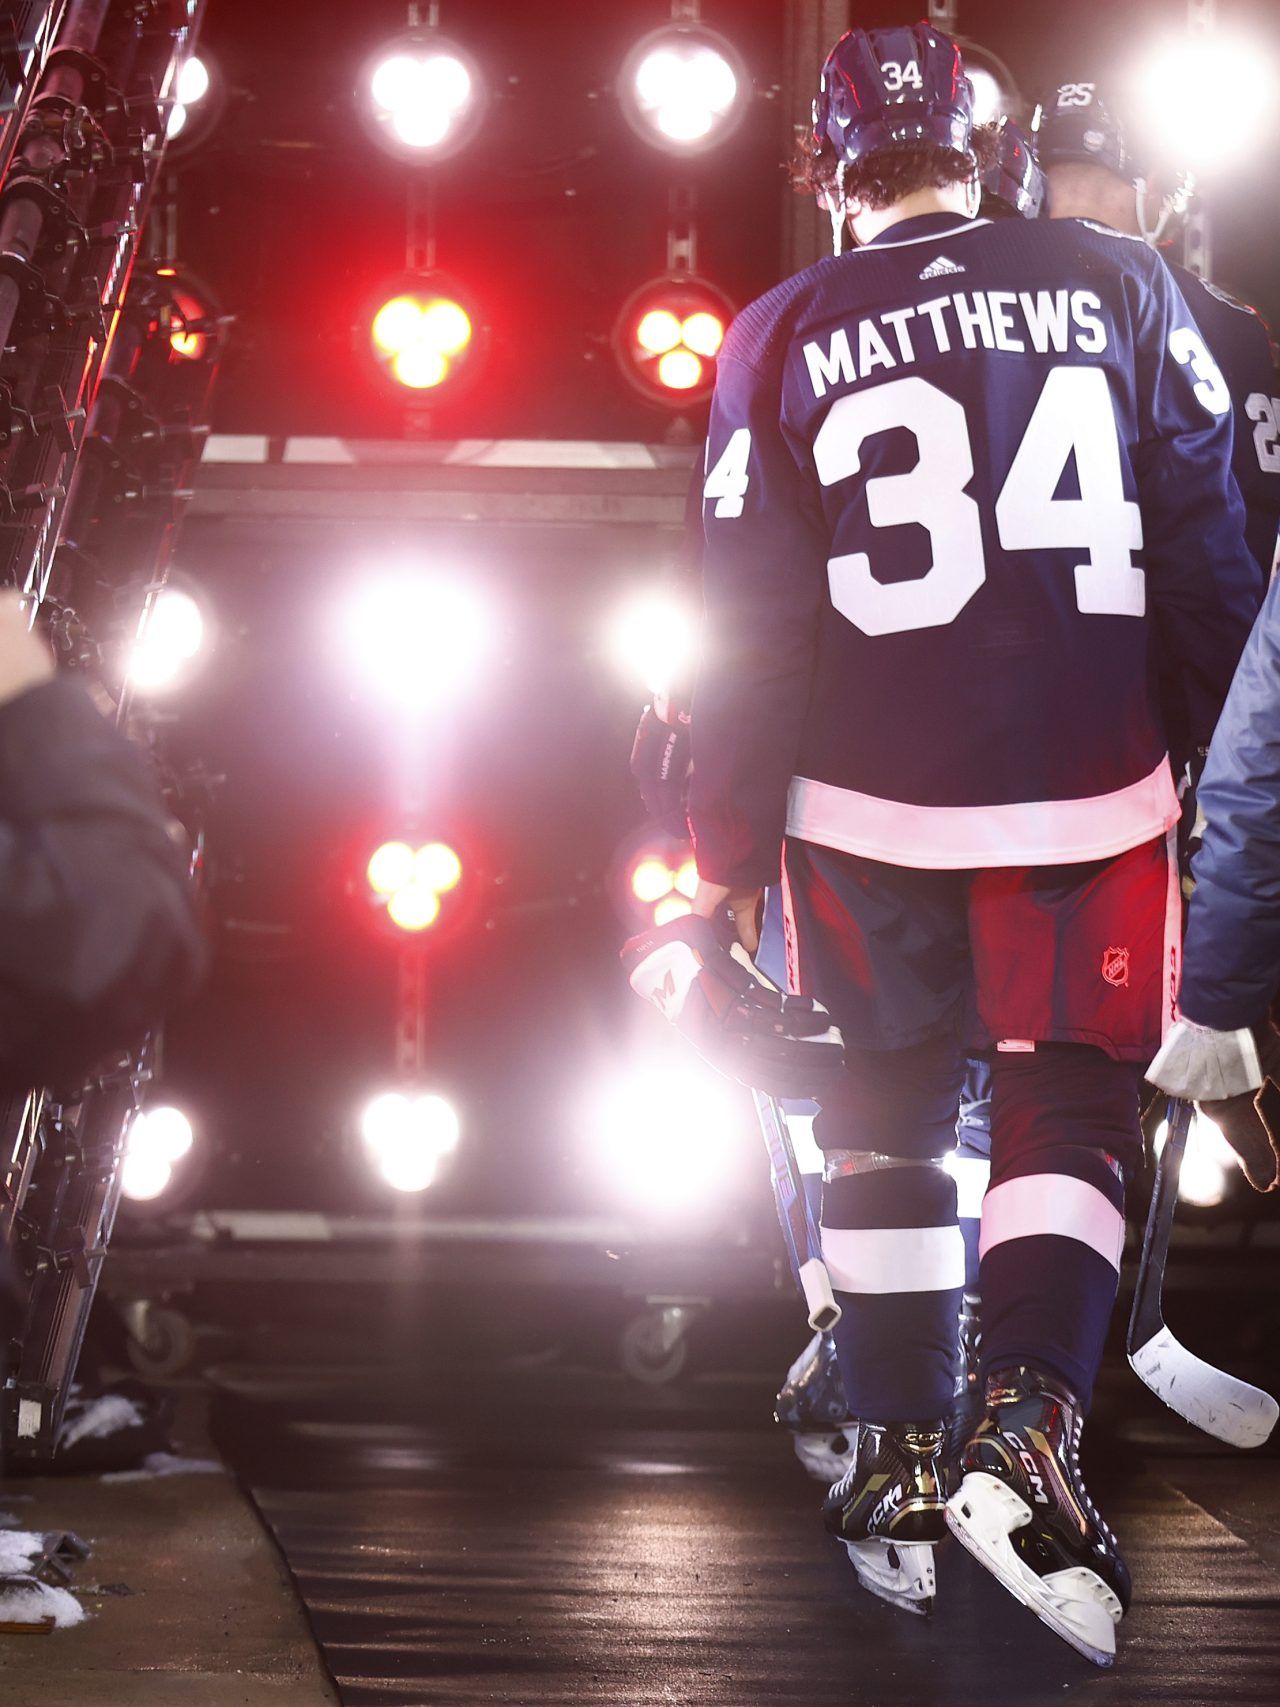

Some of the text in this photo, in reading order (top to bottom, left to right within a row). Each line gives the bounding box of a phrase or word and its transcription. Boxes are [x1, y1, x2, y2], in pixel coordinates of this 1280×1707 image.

[881, 61, 923, 91] 34
[1057, 83, 1095, 107] 25
[919, 265, 965, 280] adidas
[802, 290, 1107, 398] MATTHEWS
[813, 366, 1146, 637] 34
[784, 915, 796, 990] CCM
[1003, 1432, 1048, 1504] CCM
[867, 1484, 902, 1535] CCM
